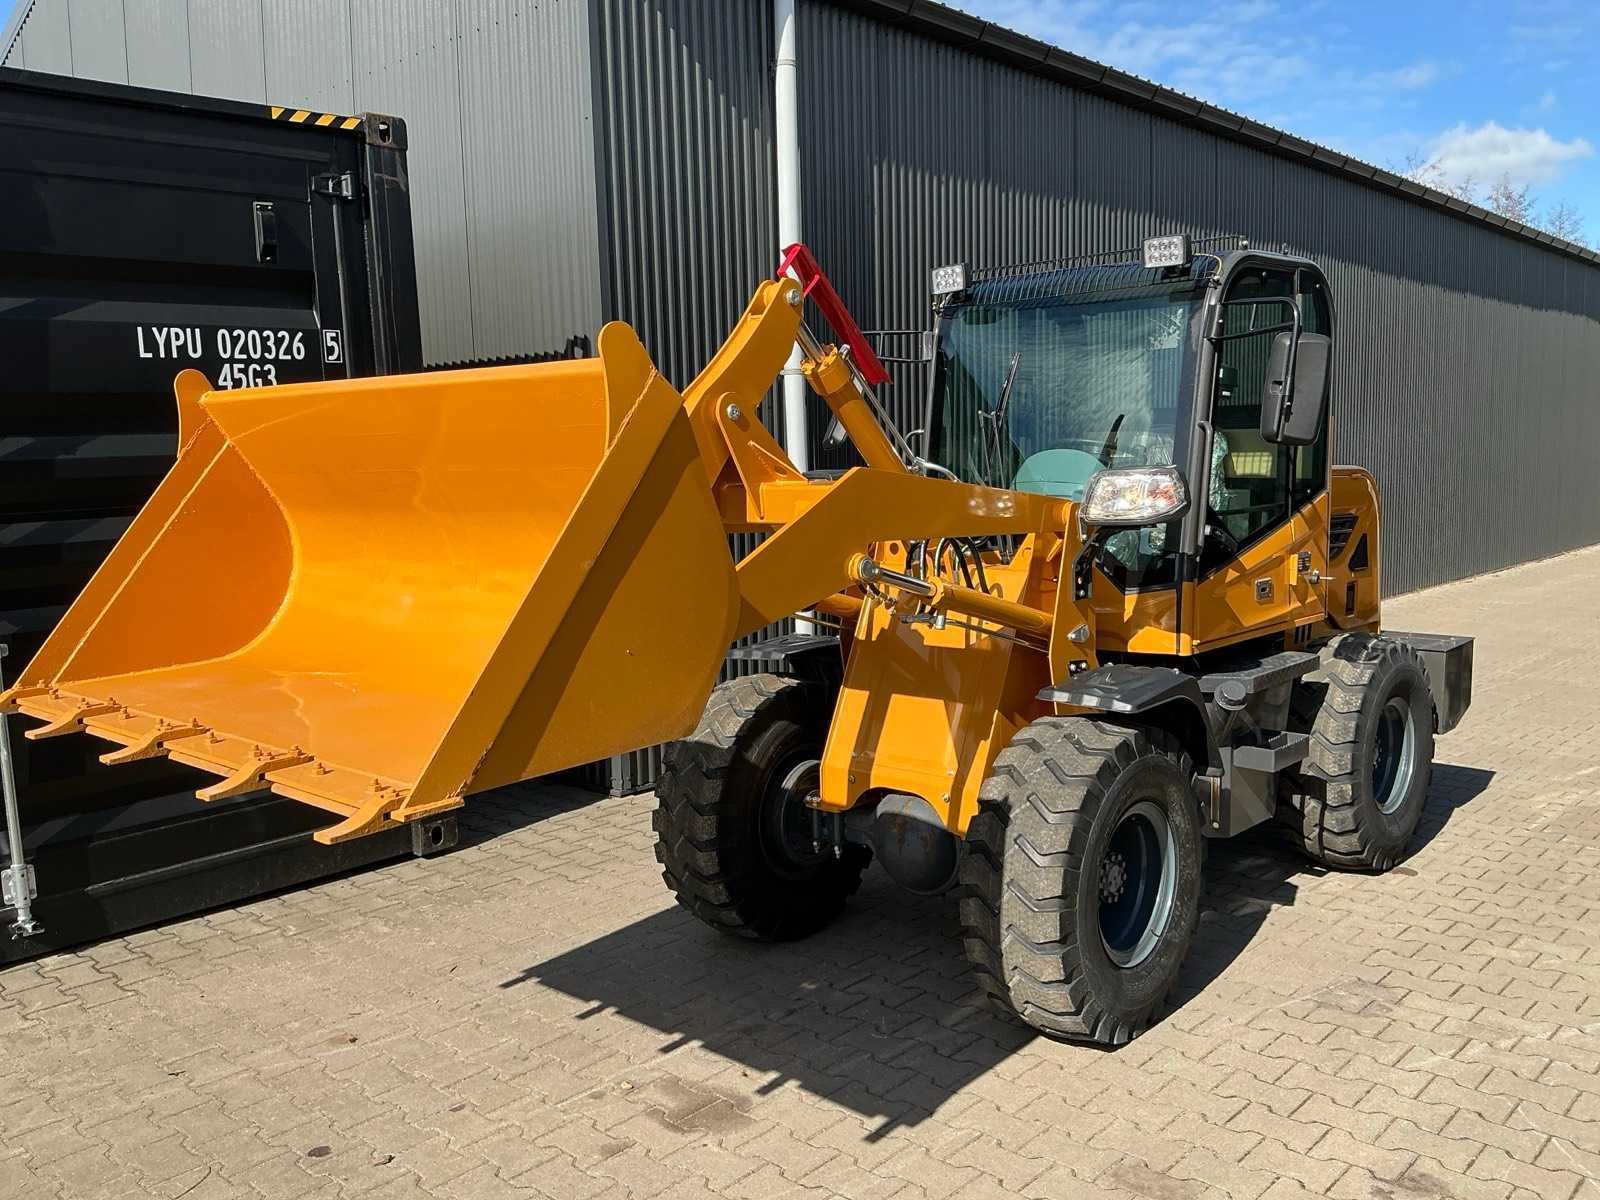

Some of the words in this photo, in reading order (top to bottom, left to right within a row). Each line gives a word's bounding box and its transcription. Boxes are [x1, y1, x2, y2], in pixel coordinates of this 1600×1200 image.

[136, 326, 202, 359] LYPU
[216, 328, 306, 360] 020326
[325, 331, 340, 361] 5
[217, 363, 278, 390] 45G3
